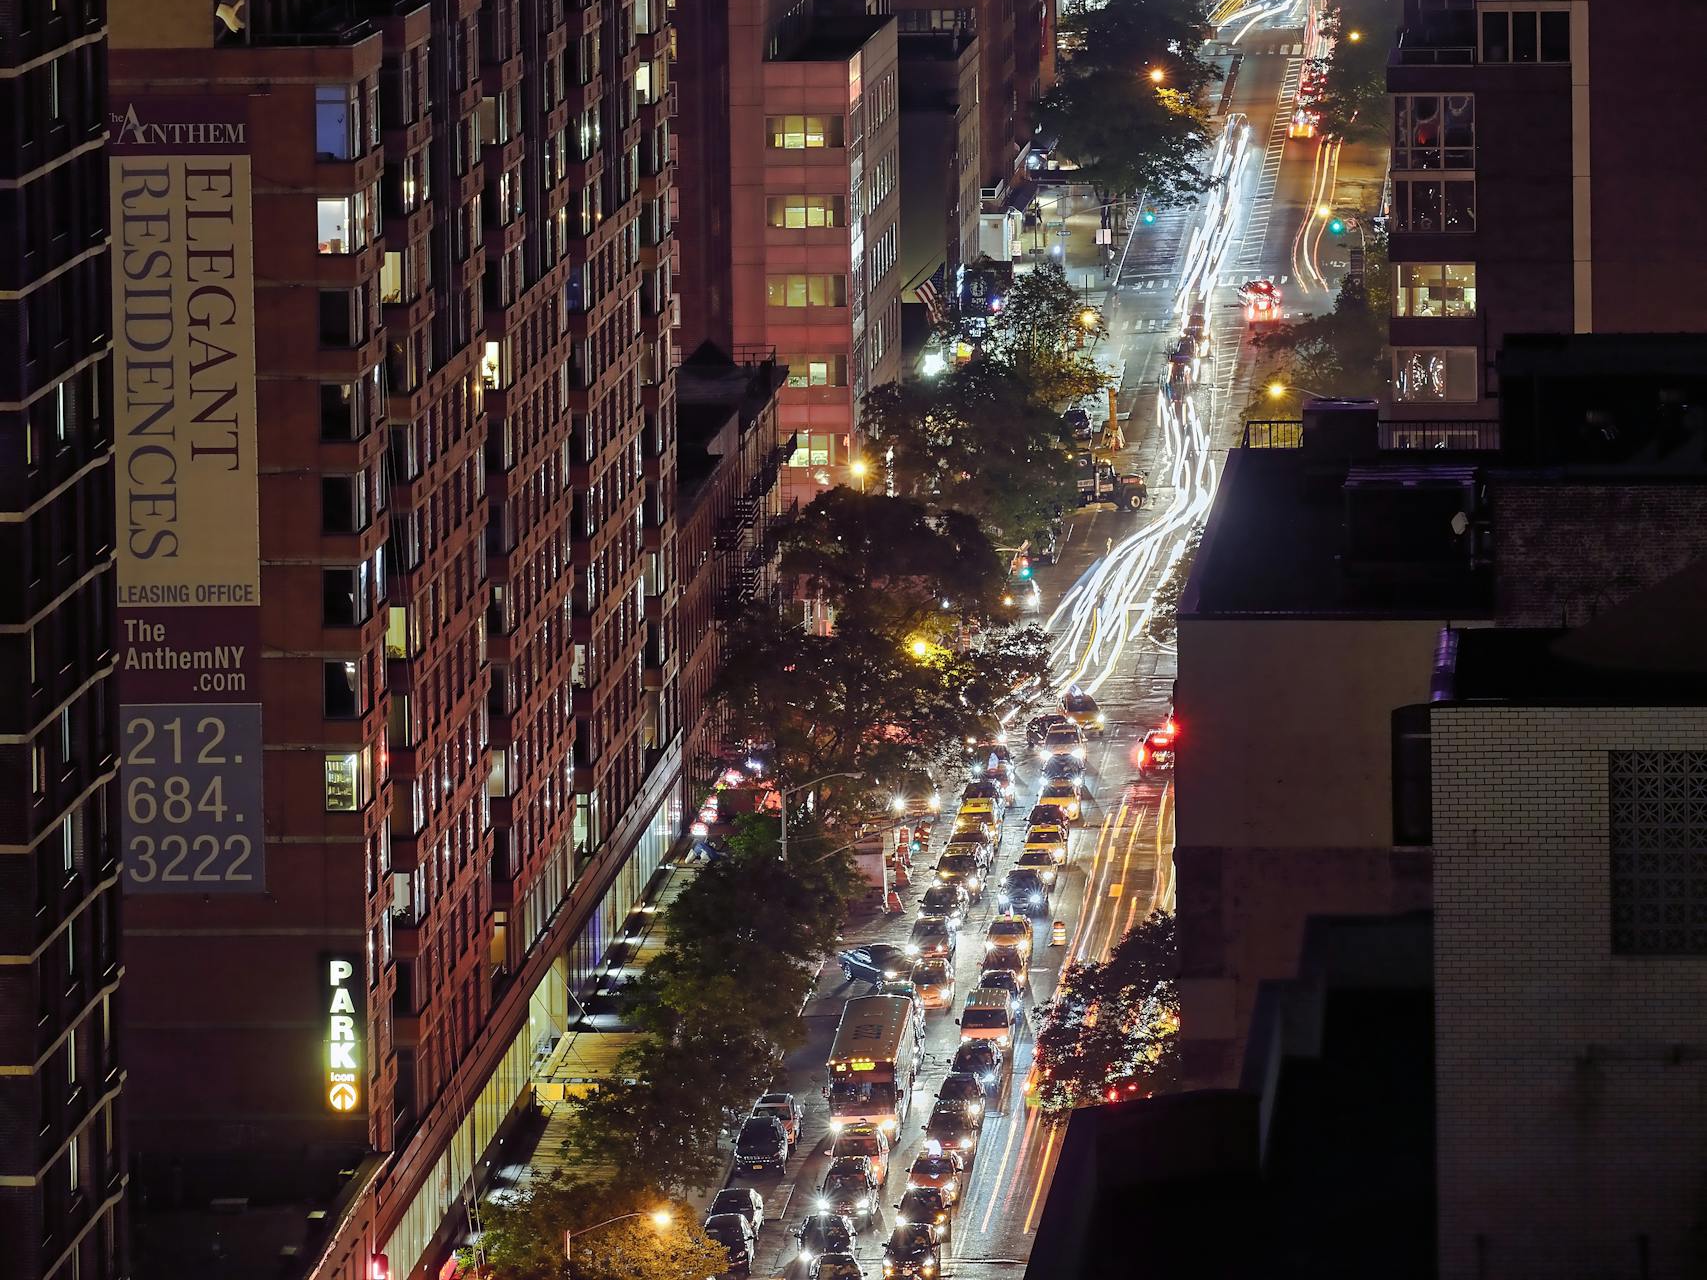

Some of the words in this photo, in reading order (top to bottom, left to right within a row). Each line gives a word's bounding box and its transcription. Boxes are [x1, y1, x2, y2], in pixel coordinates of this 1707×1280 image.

[113, 103, 247, 144] ANTHEM
[184, 162, 239, 471] ELEGANT
[121, 162, 179, 560] RESIDENCES
[118, 585, 190, 604] LEASING
[195, 584, 253, 602] OFFICE
[124, 620, 165, 642] The
[124, 647, 245, 670] AnthemNY
[193, 672, 246, 691] .com
[127, 717, 243, 764] 212.
[127, 776, 244, 824] 684.
[129, 834, 252, 882] 3222
[329, 960, 356, 1069] PARK
